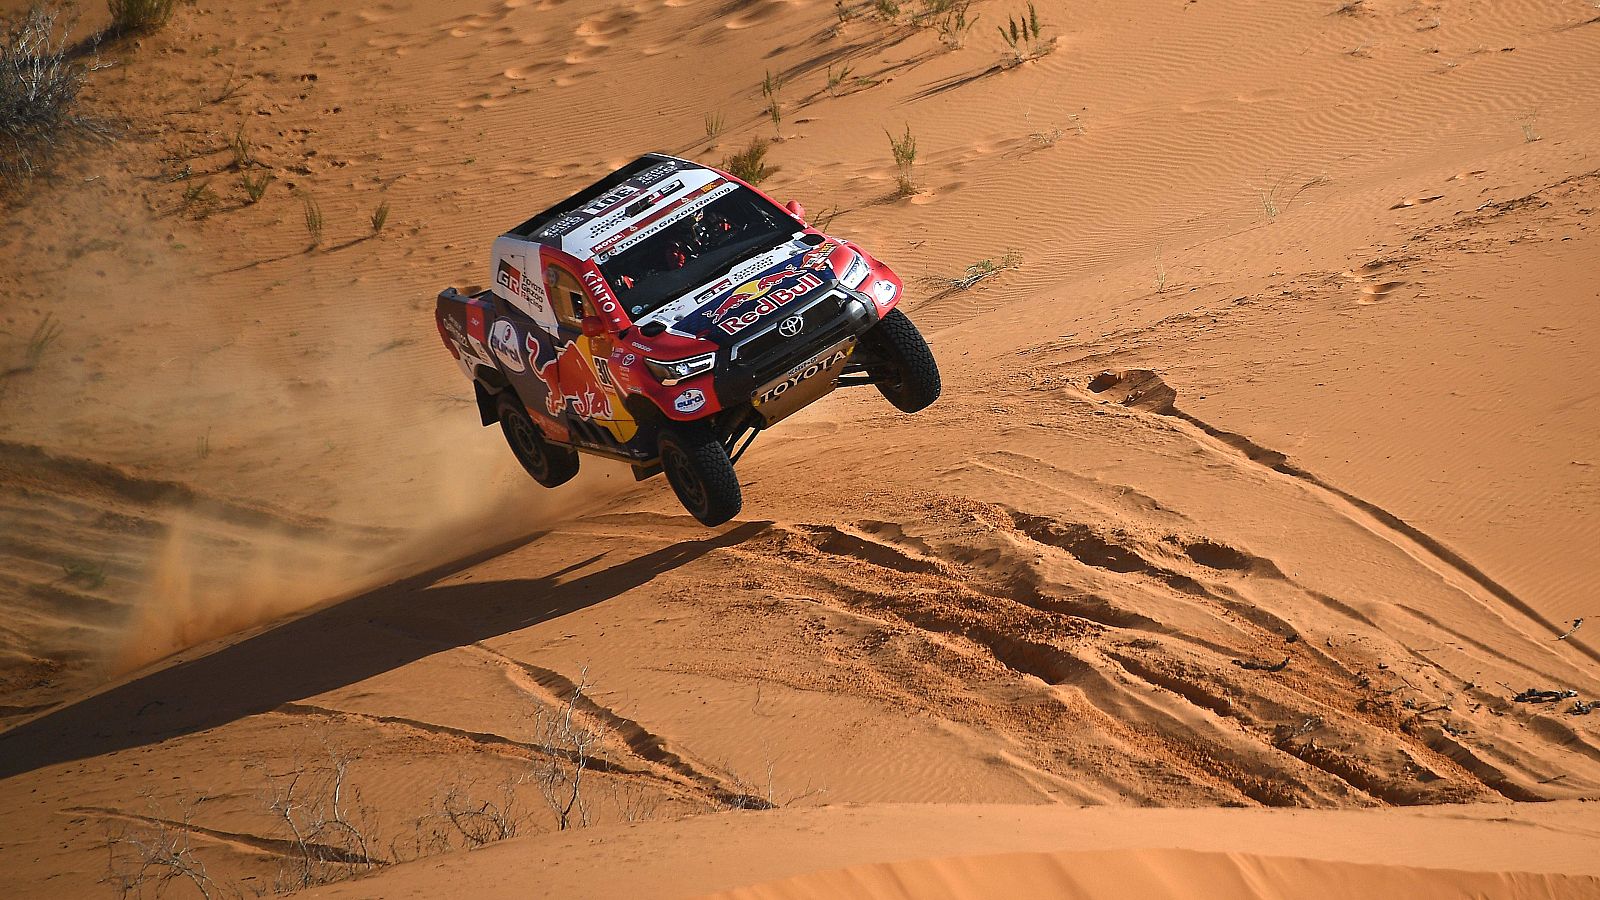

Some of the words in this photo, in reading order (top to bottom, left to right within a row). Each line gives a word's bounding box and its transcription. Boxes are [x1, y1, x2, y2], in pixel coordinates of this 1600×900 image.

[620, 225, 659, 250] TOYOTA
[695, 187, 731, 209] Racing
[594, 234, 623, 252] MOTUL
[498, 270, 520, 294] GR
[522, 274, 545, 295] TOYOTA
[521, 291, 543, 312] Racing
[717, 297, 778, 335] Red
[768, 272, 824, 307] Bull
[760, 350, 846, 403] TOYOTA
[677, 393, 704, 409] eurol
